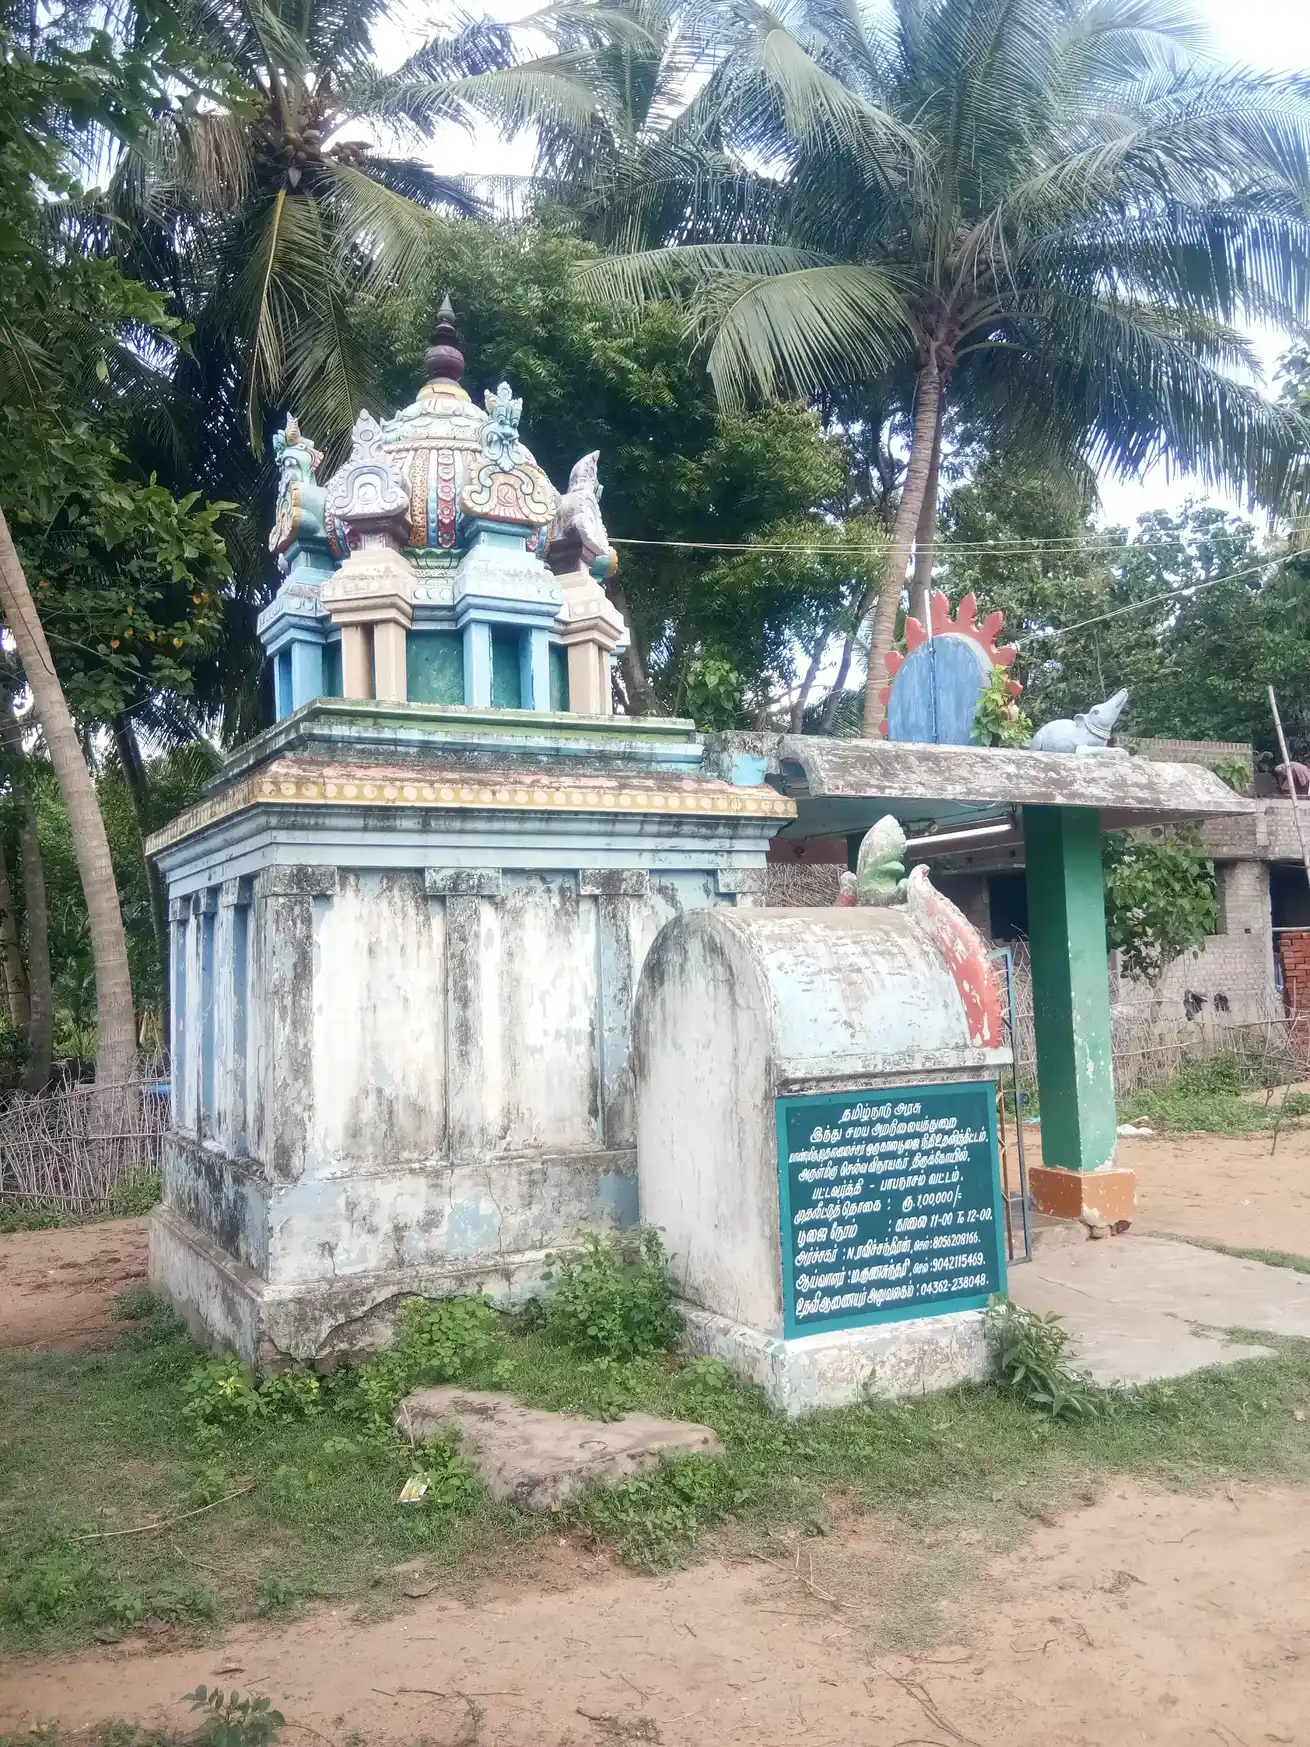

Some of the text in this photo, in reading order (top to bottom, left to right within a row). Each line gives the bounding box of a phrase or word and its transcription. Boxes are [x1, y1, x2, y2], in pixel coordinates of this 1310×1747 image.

[838, 1102, 921, 1123] தமிழ்நாடு அரசு
[810, 1126, 842, 1143] இந்து
[845, 1128, 869, 1139] சமய
[880, 1170, 926, 1191] பாபநாசம்
[798, 1226, 827, 1247] பூஜை
[830, 1219, 858, 1241] நேரம்
[895, 1216, 927, 1231] காலை
[930, 1212, 953, 1227] 11-00
